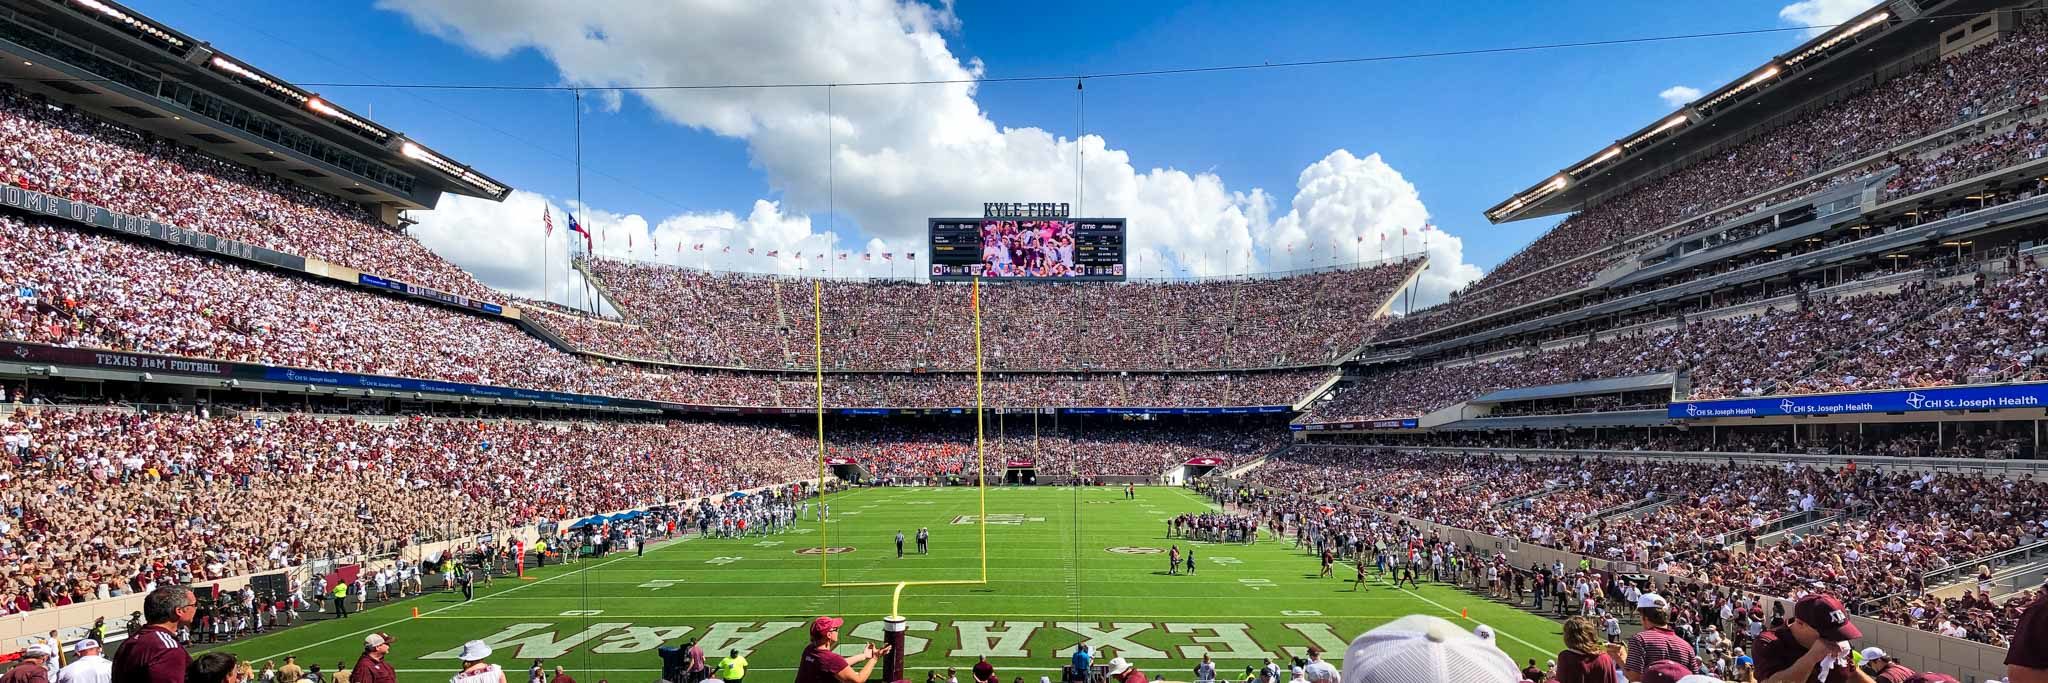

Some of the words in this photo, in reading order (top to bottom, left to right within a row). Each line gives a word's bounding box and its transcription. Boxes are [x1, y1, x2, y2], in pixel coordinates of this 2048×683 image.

[984, 202, 1022, 217] KYLE
[1028, 202, 1070, 217] FIELD
[0, 185, 58, 214] OME
[71, 203, 97, 223] OF
[110, 212, 150, 234] THE
[160, 224, 207, 247] 12TH
[215, 238, 253, 259] MAN
[96, 353, 137, 367] TEXAS
[141, 357, 166, 369] A&M
[170, 360, 221, 373] FOOTBALL
[1793, 405, 1806, 413] CHI
[1807, 404, 1817, 412] St.
[1817, 403, 1844, 413] Joseph
[1845, 402, 1873, 411] Health
[1925, 399, 1942, 408] CHI
[1944, 399, 1957, 407] St.
[1958, 397, 1996, 408] Joseph
[1999, 395, 2038, 405] Health
[1714, 408, 1735, 417] Joseph
[1735, 407, 1756, 415] Health
[417, 620, 806, 660] A&M
[832, 619, 1346, 660] TEXAS
